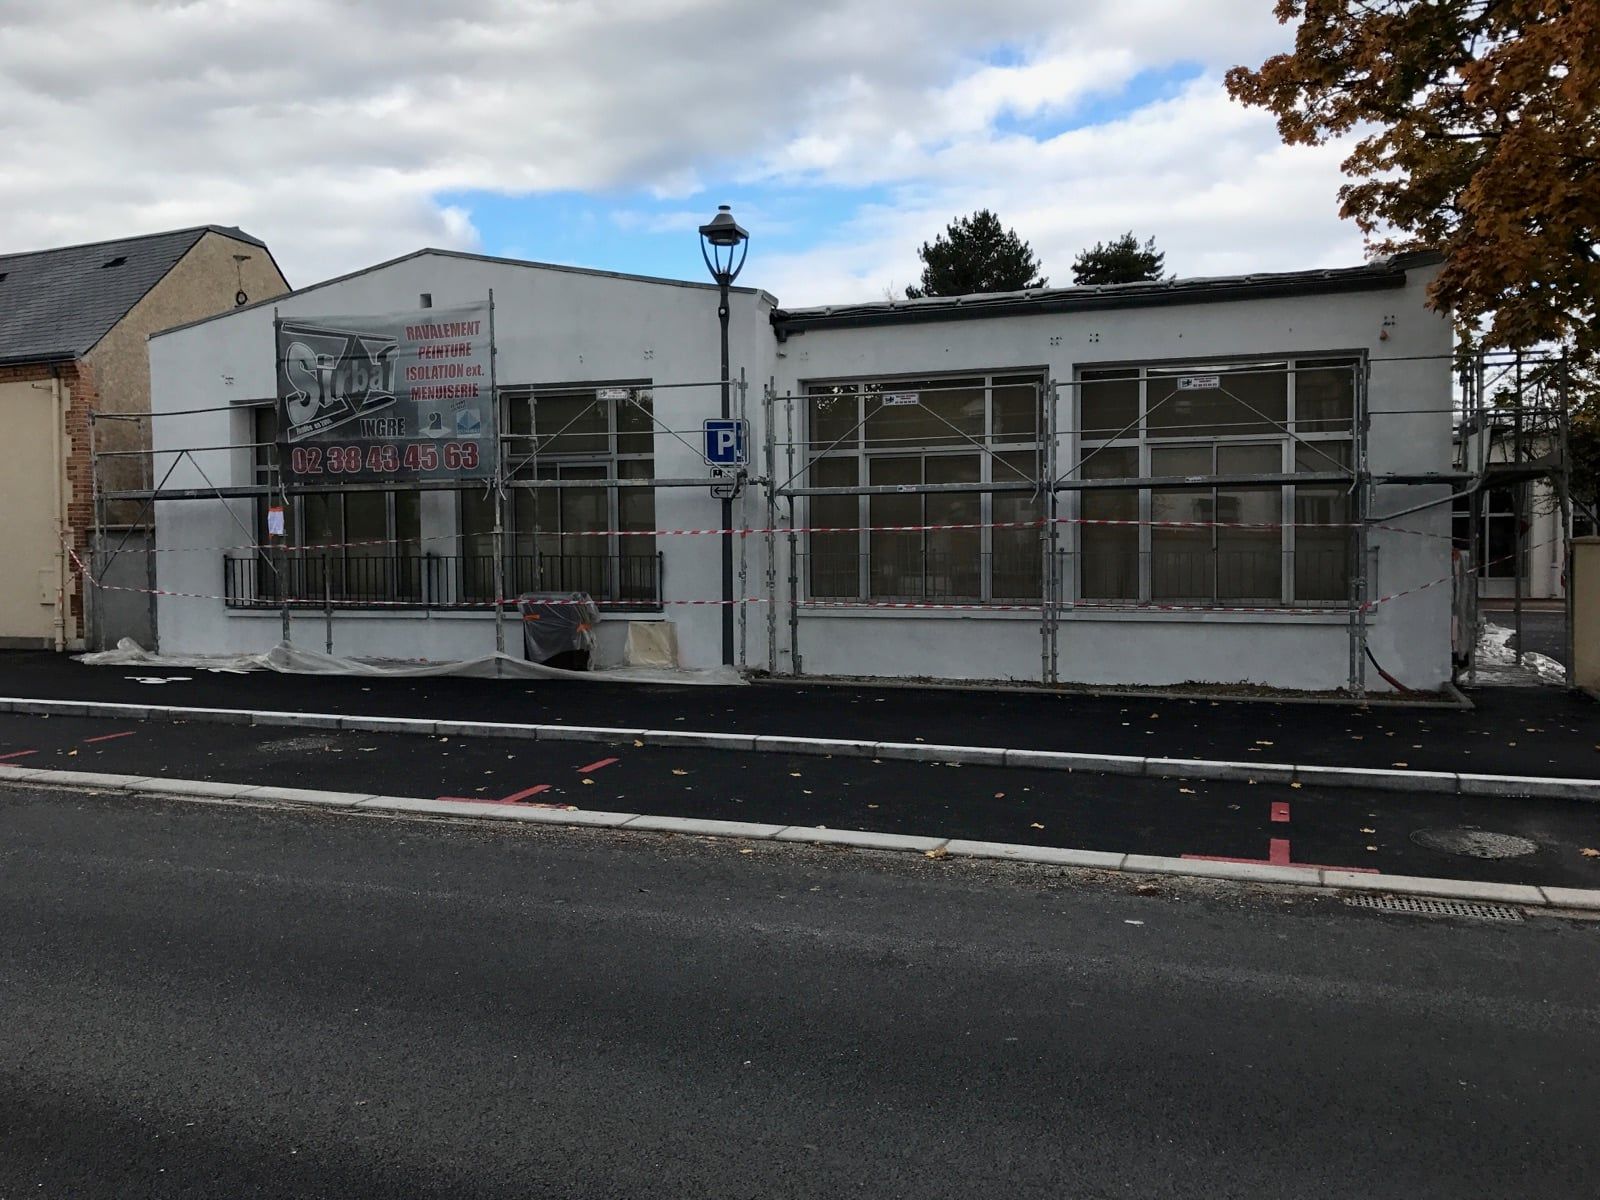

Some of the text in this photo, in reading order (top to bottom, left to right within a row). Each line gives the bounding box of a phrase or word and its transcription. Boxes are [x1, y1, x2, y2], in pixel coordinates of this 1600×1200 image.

[405, 320, 481, 341] RAVALEMENT
[418, 342, 472, 360] PEINTURE
[405, 363, 485, 381] ISOLATION ext.
[410, 383, 479, 401] MENUISERIE
[360, 417, 406, 438] INGRE
[717, 429, 736, 456] P
[292, 442, 480, 474] 02 38 43 45 63
